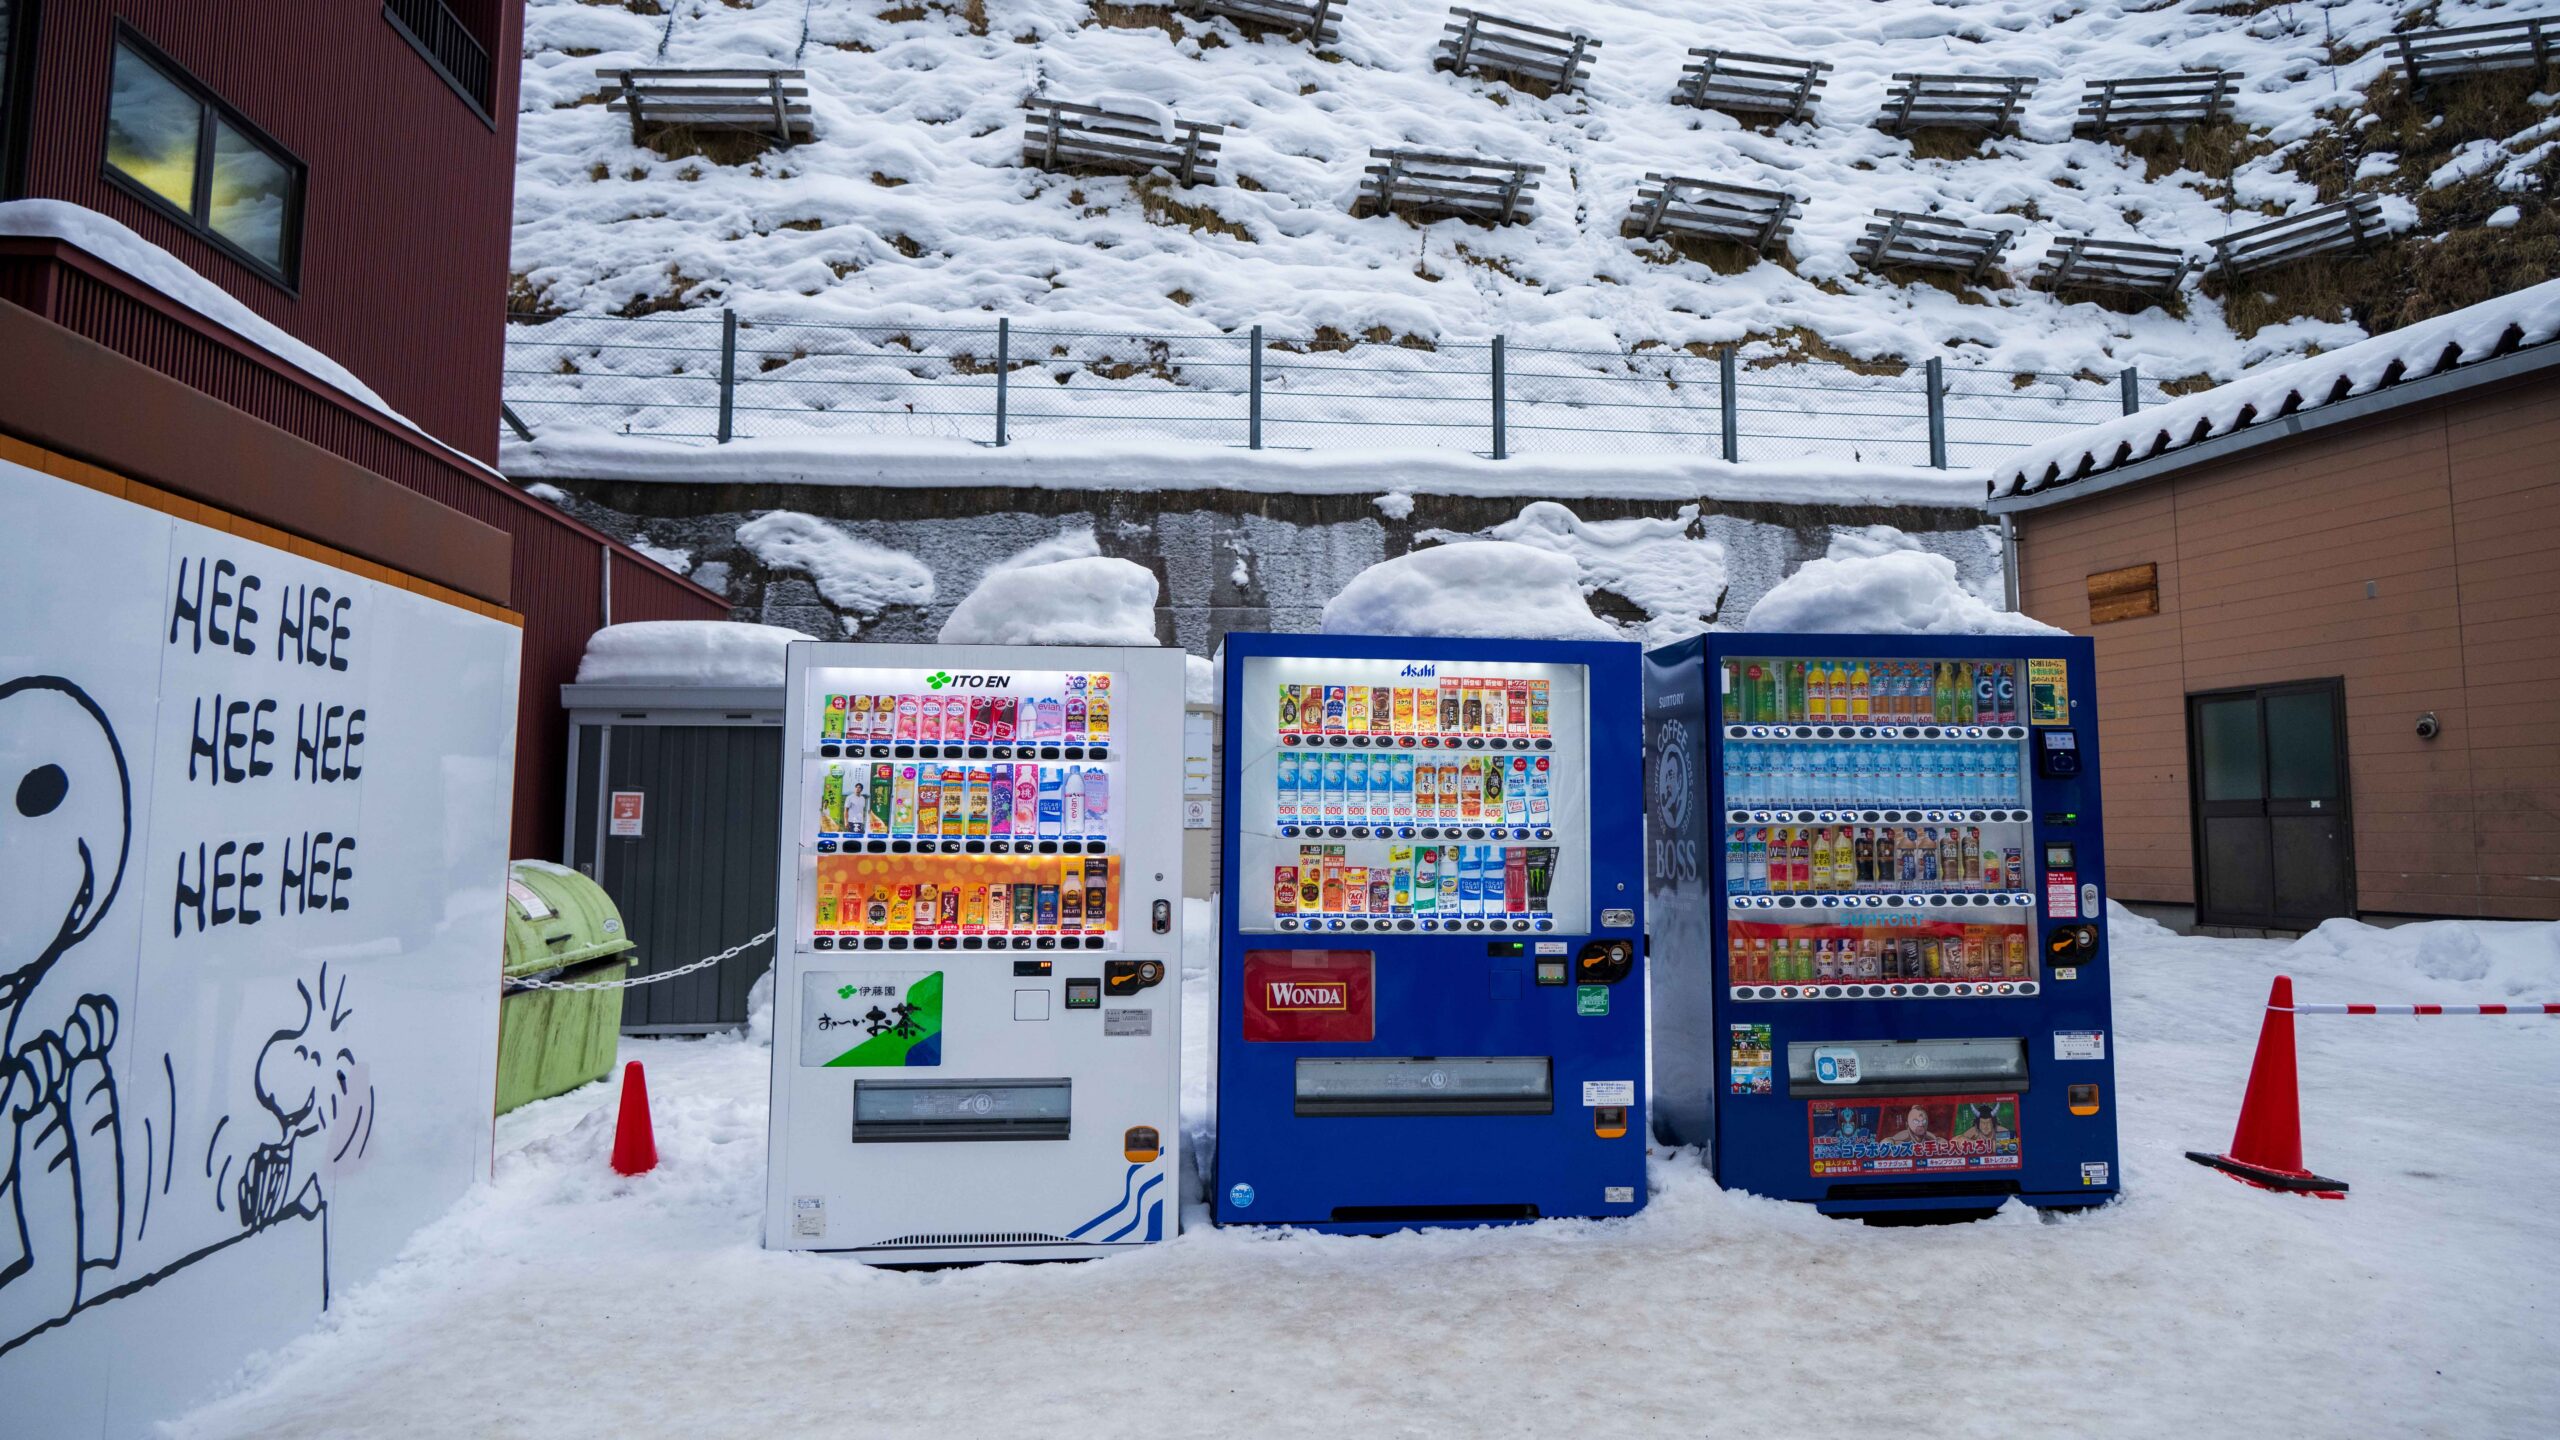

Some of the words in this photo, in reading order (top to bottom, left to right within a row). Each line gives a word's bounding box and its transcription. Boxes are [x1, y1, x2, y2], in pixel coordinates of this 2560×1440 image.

[170, 557, 260, 655] HEE
[278, 584, 351, 671] HEE
[1400, 663, 1436, 678] Asahi
[951, 675, 984, 688] ITO
[985, 676, 1010, 688] EN
[1038, 703, 1061, 711] evian
[1658, 692, 1685, 709] SUNTORY
[190, 694, 276, 785] HEE
[294, 702, 366, 783] HEE
[1656, 718, 1688, 751] COFFEE
[919, 791, 940, 800] むぎ茶
[1020, 789, 1031, 798] 桃
[1655, 839, 1697, 882] BOSS
[174, 840, 264, 937] HEE
[281, 832, 355, 916] HEE
[1840, 911, 1924, 927] SUNTORY
[858, 985, 896, 997] 伊藤園
[1270, 982, 1342, 1006] WONDA
